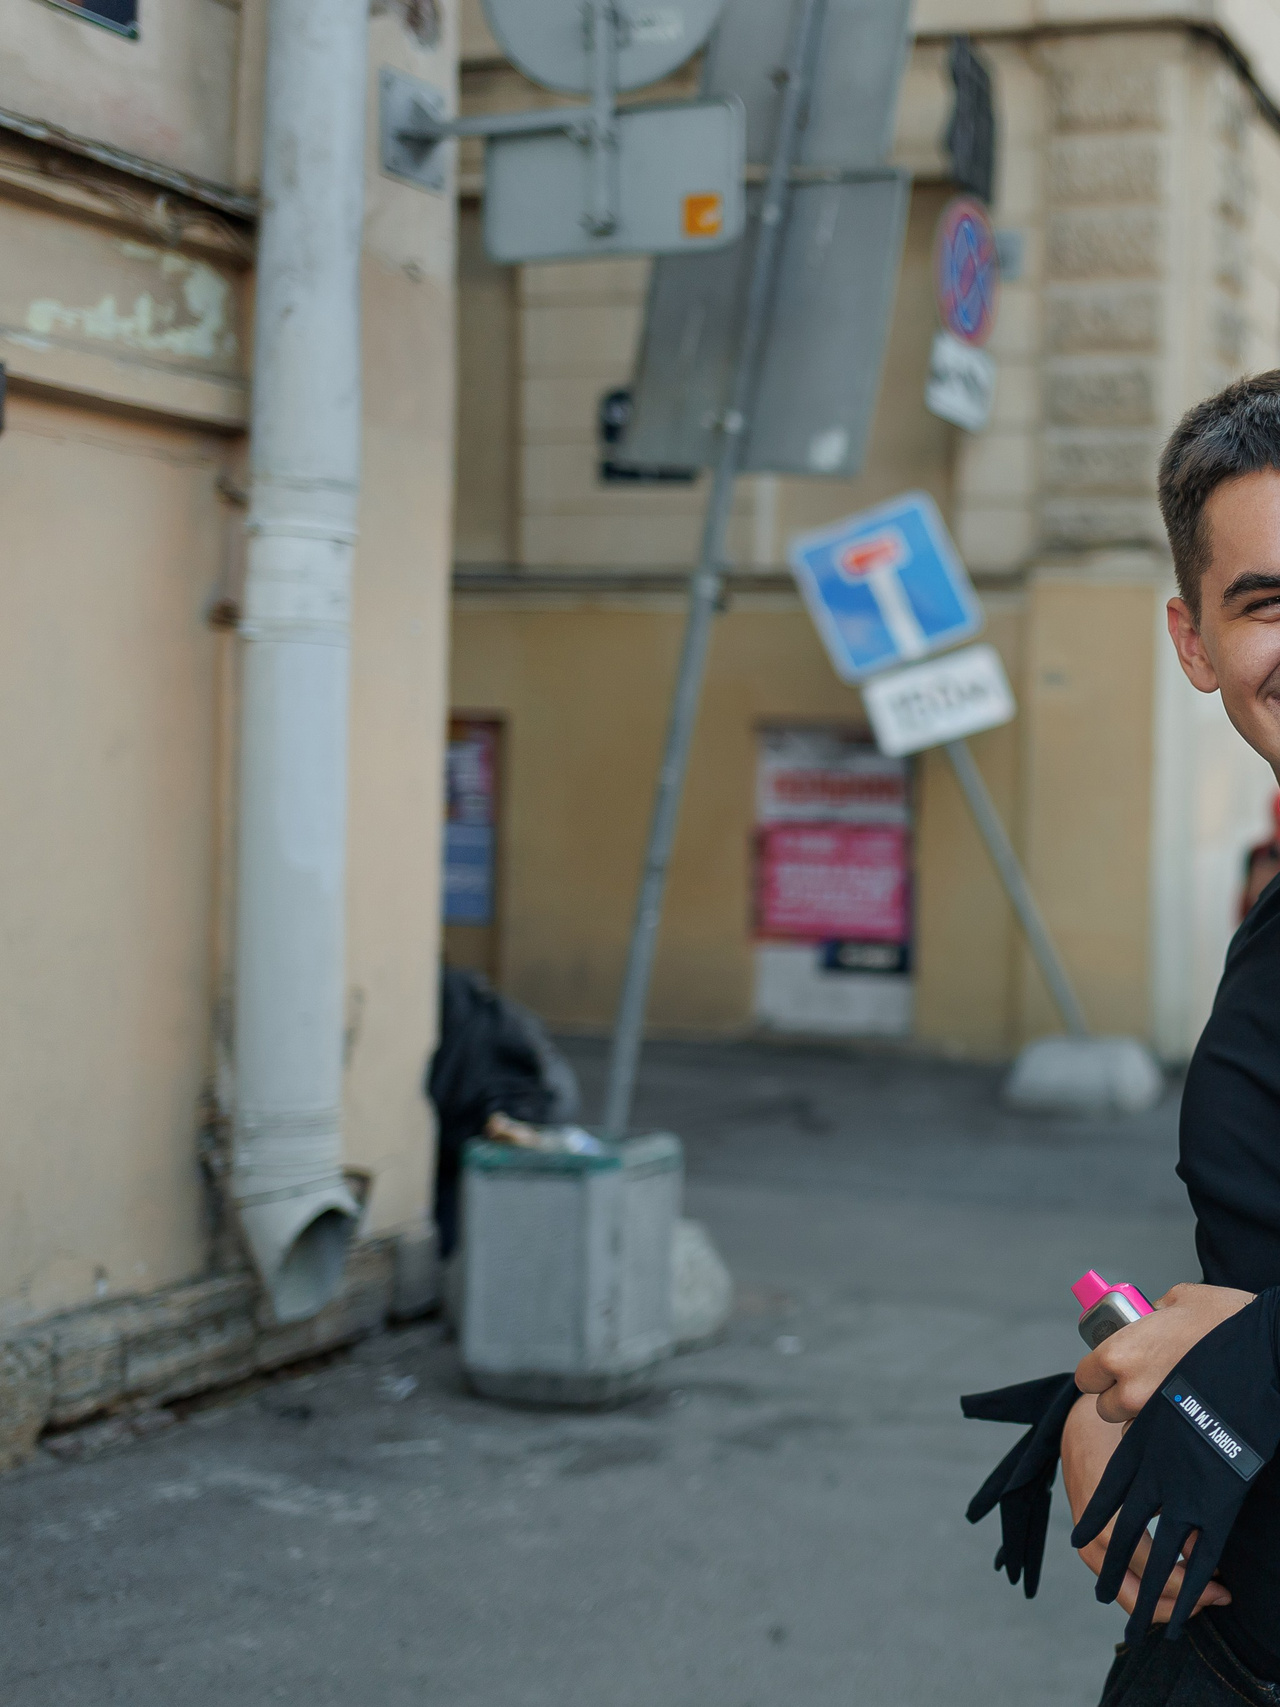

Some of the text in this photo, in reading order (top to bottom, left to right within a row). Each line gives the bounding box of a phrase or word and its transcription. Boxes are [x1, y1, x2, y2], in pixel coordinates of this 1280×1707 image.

[1179, 1395, 1242, 1459] SORRY, I'M NOT
